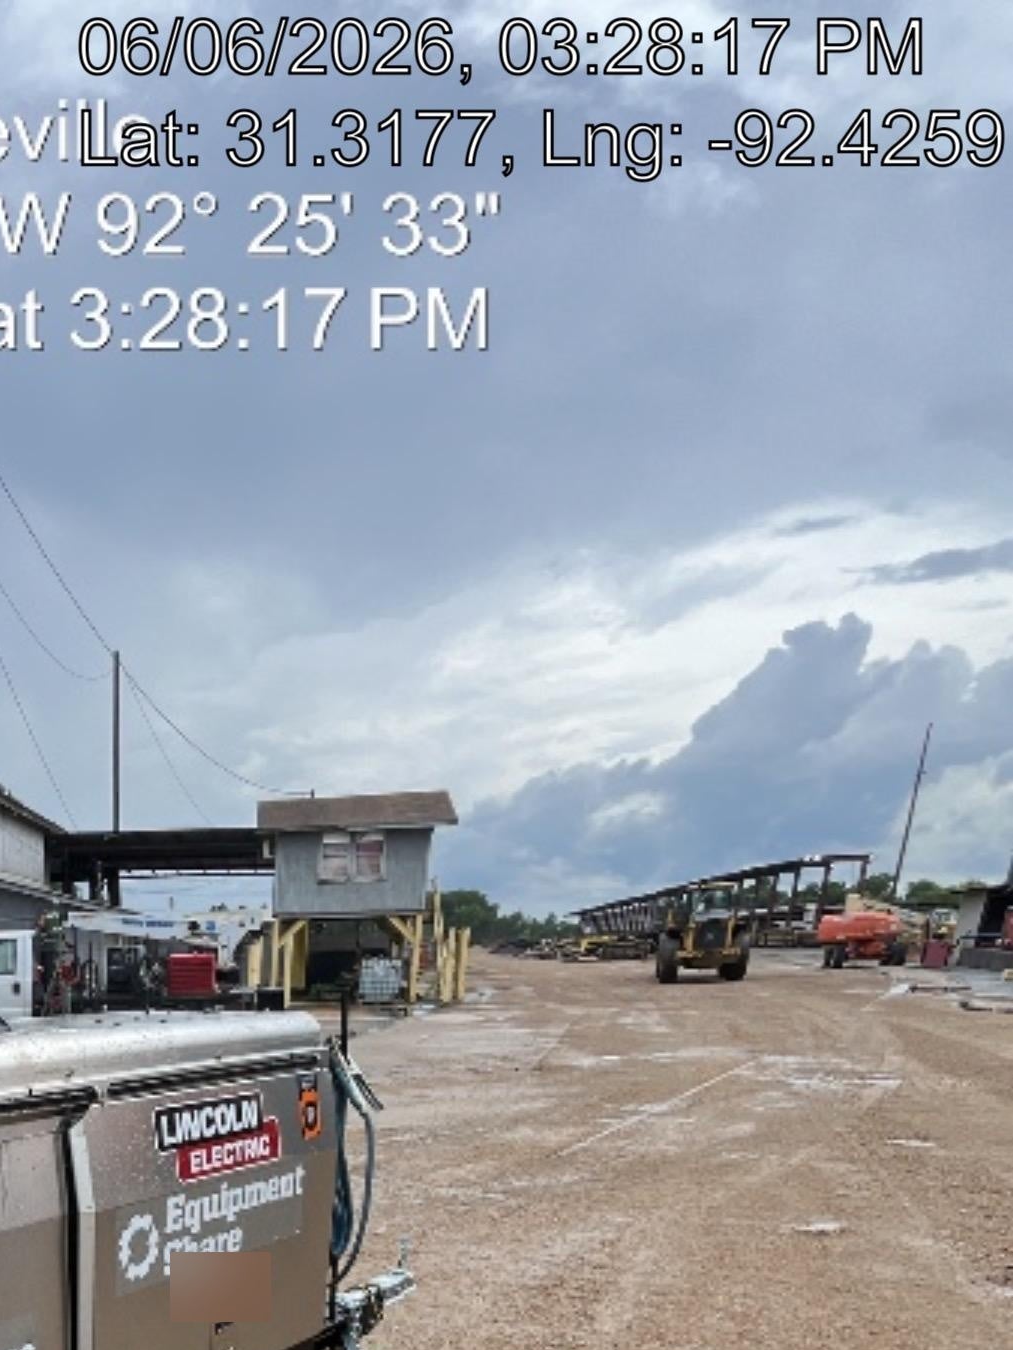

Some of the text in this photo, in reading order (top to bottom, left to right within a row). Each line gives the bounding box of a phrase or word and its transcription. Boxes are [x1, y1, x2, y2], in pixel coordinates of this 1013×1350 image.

[160, 1100, 259, 1146] LINCOLN
[190, 1135, 271, 1174] ELECTRIC
[164, 1164, 305, 1233] Equipment
